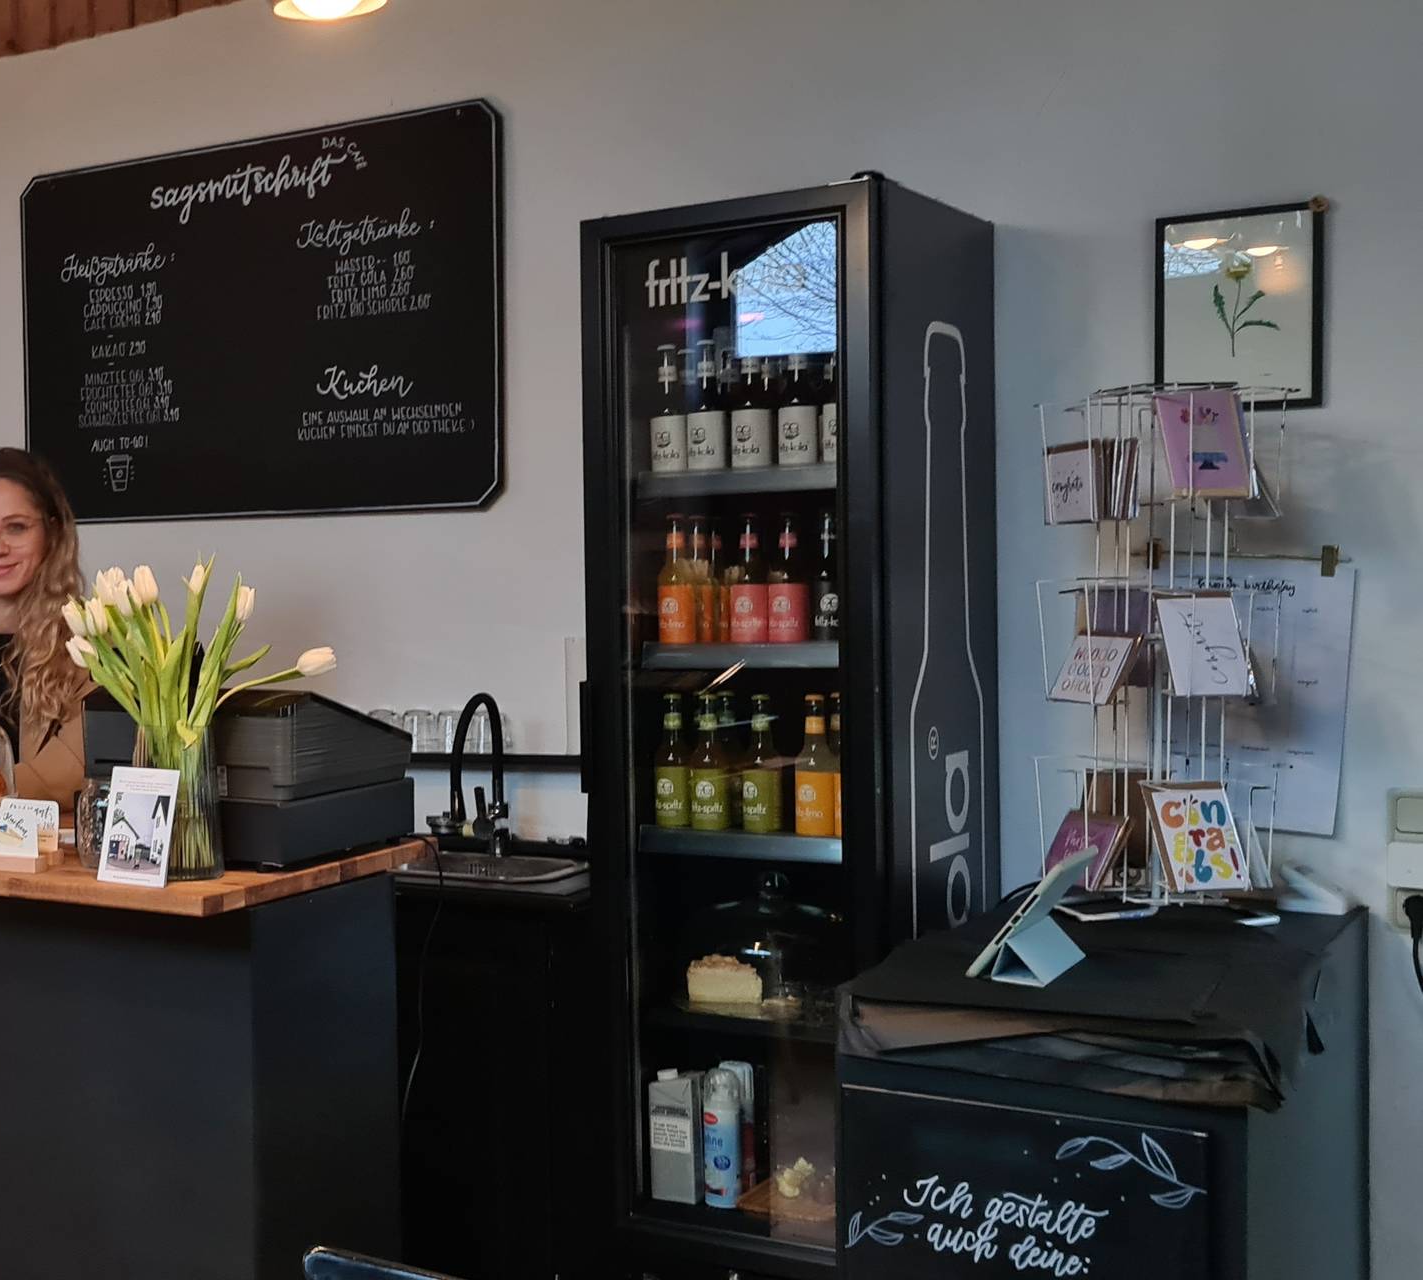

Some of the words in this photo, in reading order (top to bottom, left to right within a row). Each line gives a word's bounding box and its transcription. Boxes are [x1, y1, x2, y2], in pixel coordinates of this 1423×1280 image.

[322, 136, 346, 150] DAS
[150, 154, 347, 225] sagsmitschrift
[335, 255, 375, 274] WASSER
[327, 273, 355, 289] FRITZ
[360, 270, 387, 286] COLA
[89, 284, 133, 303] ESPRESSO
[331, 287, 358, 304] FRITZ
[361, 283, 387, 301] LIMO
[83, 298, 142, 318] CAPPUCCINO
[317, 303, 346, 320] FRITZ
[92, 342, 126, 359] KAKAO
[85, 369, 126, 385] MINZTEE
[316, 364, 413, 400] Kuchen
[302, 411, 323, 427] EINE
[326, 408, 370, 424] AUSWAHL
[373, 406, 387, 421] AN
[391, 402, 463, 420] WECHSELNDEN
[297, 426, 336, 441] KUCHEN
[340, 423, 378, 439] FINDEST
[383, 421, 395, 436] DU
[396, 421, 409, 436] AN
[413, 419, 430, 435] DER
[432, 418, 466, 434] THEKE
[91, 438, 115, 452] AUCH
[903, 1174, 973, 1219] Ich
[977, 1191, 1109, 1245] gestalte
[927, 1222, 998, 1263] auch
[1009, 1235, 1091, 1277] deine:
